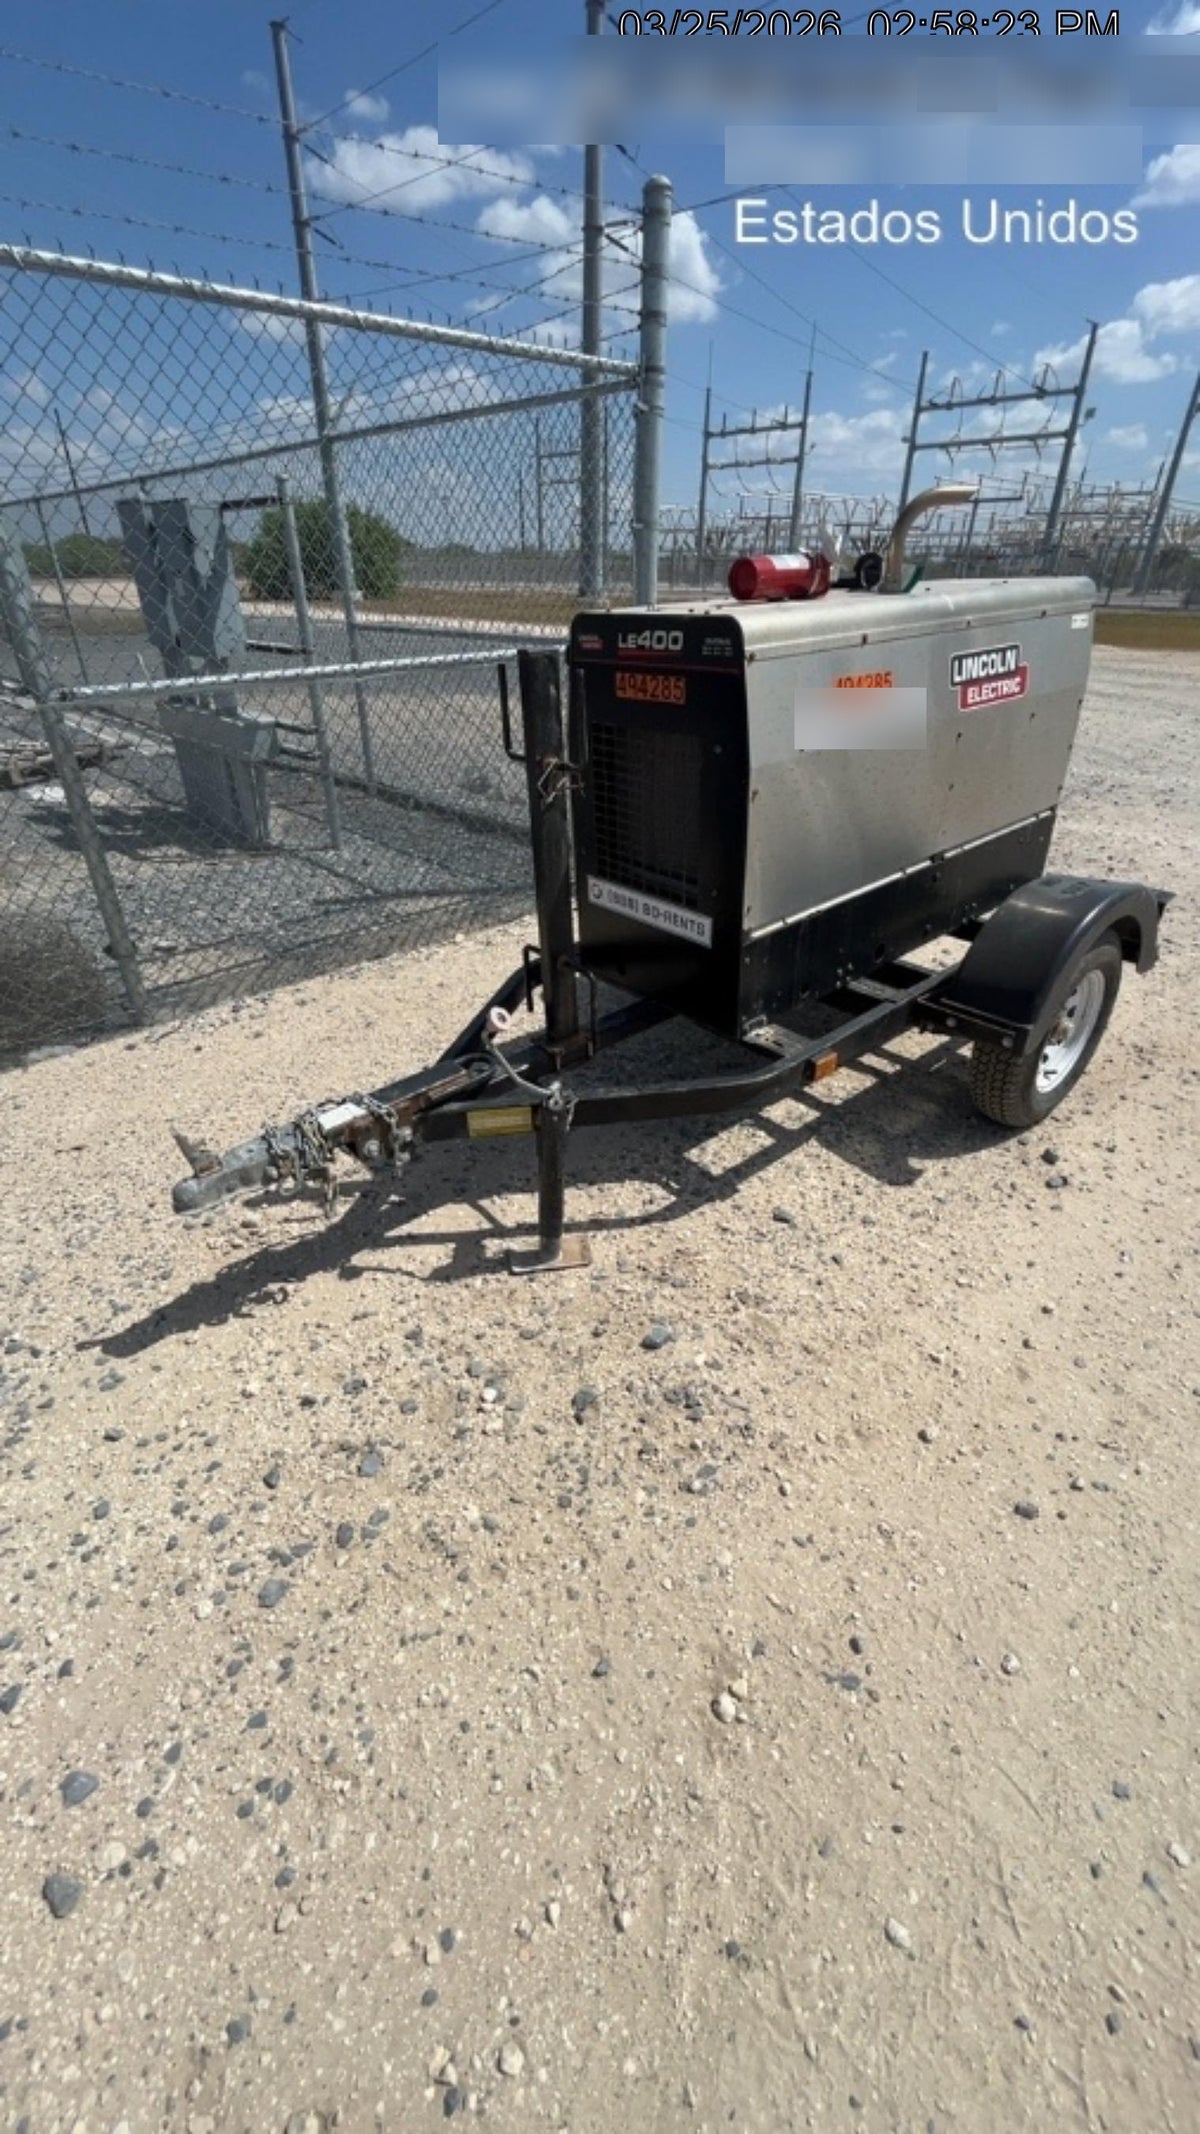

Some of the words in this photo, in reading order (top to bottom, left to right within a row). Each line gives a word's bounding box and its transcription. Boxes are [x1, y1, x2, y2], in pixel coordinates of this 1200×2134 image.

[618, 630, 684, 650] LE400
[953, 649, 1017, 682] LINCOLN
[967, 676, 1021, 704] ELECTRIC
